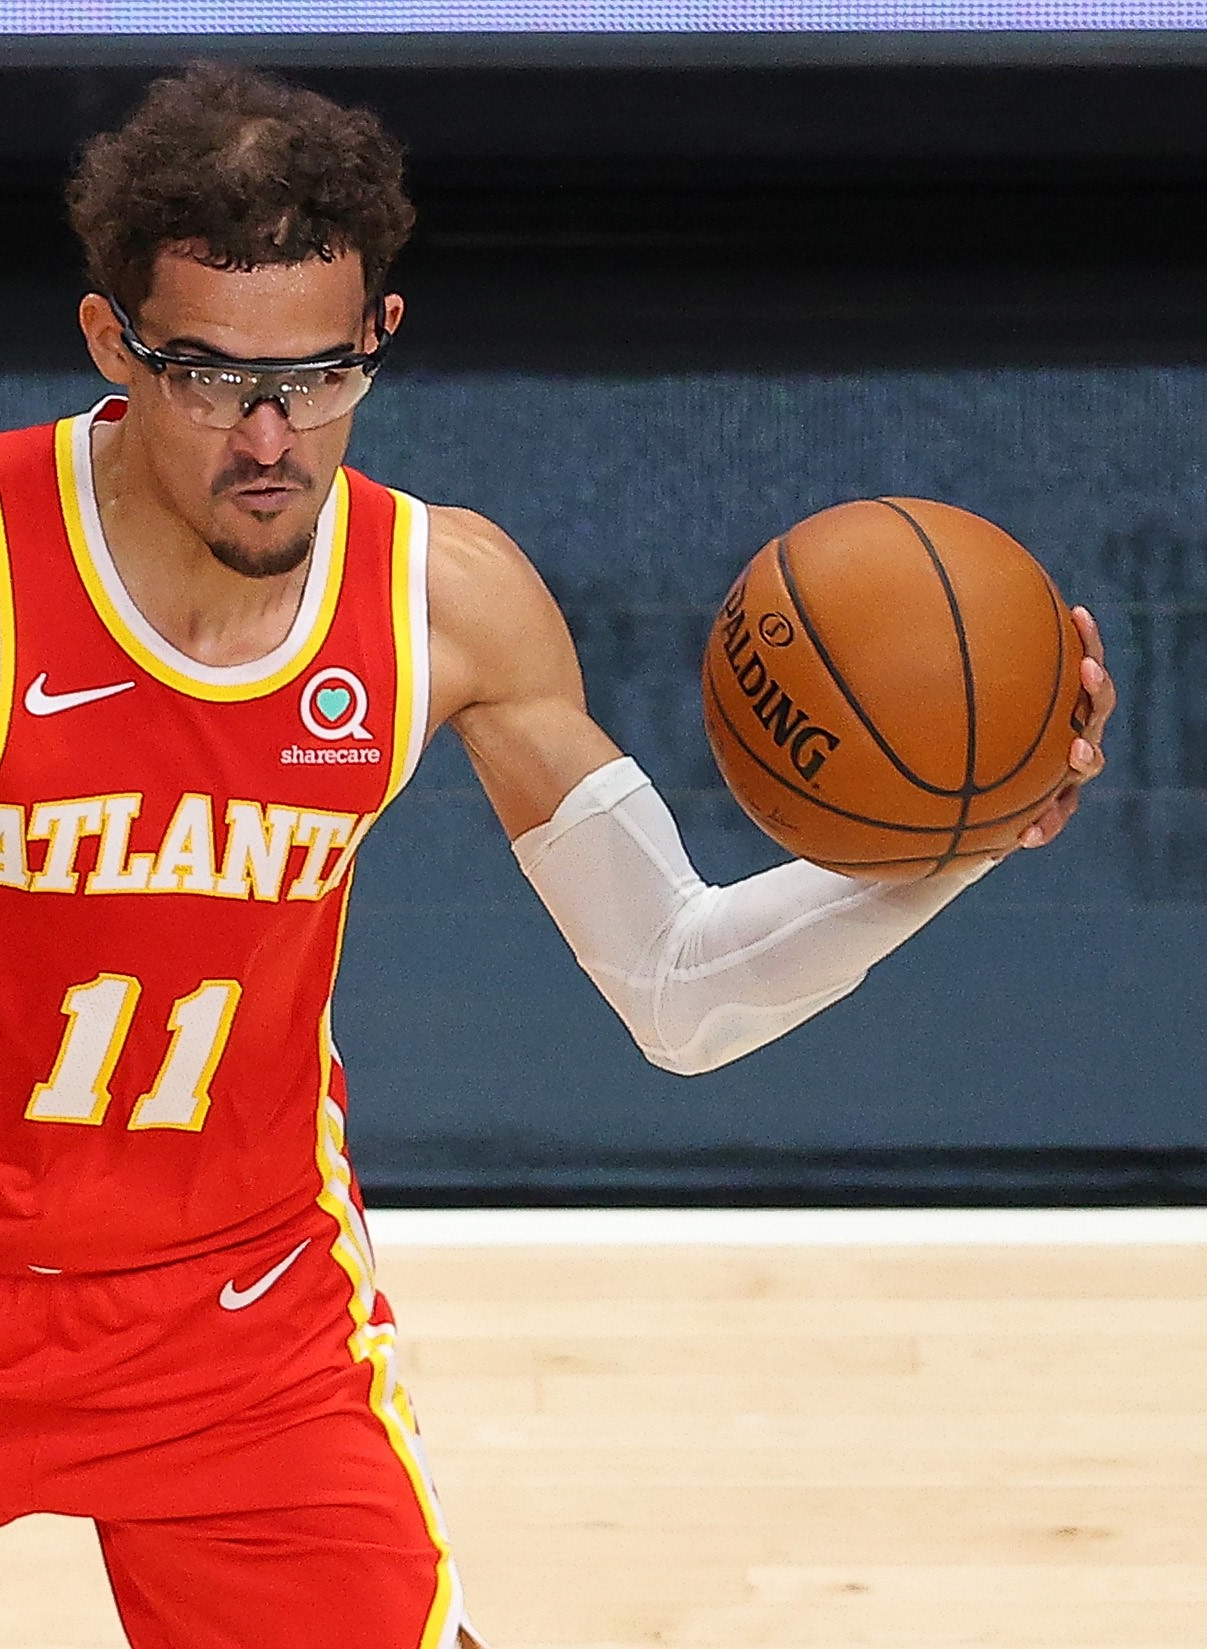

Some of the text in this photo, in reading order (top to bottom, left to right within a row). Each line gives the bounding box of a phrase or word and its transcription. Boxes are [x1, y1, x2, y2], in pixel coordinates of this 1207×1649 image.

[280, 744, 381, 764] sharecare
[721, 583, 841, 782] PALDING
[24, 972, 243, 1133] 11
